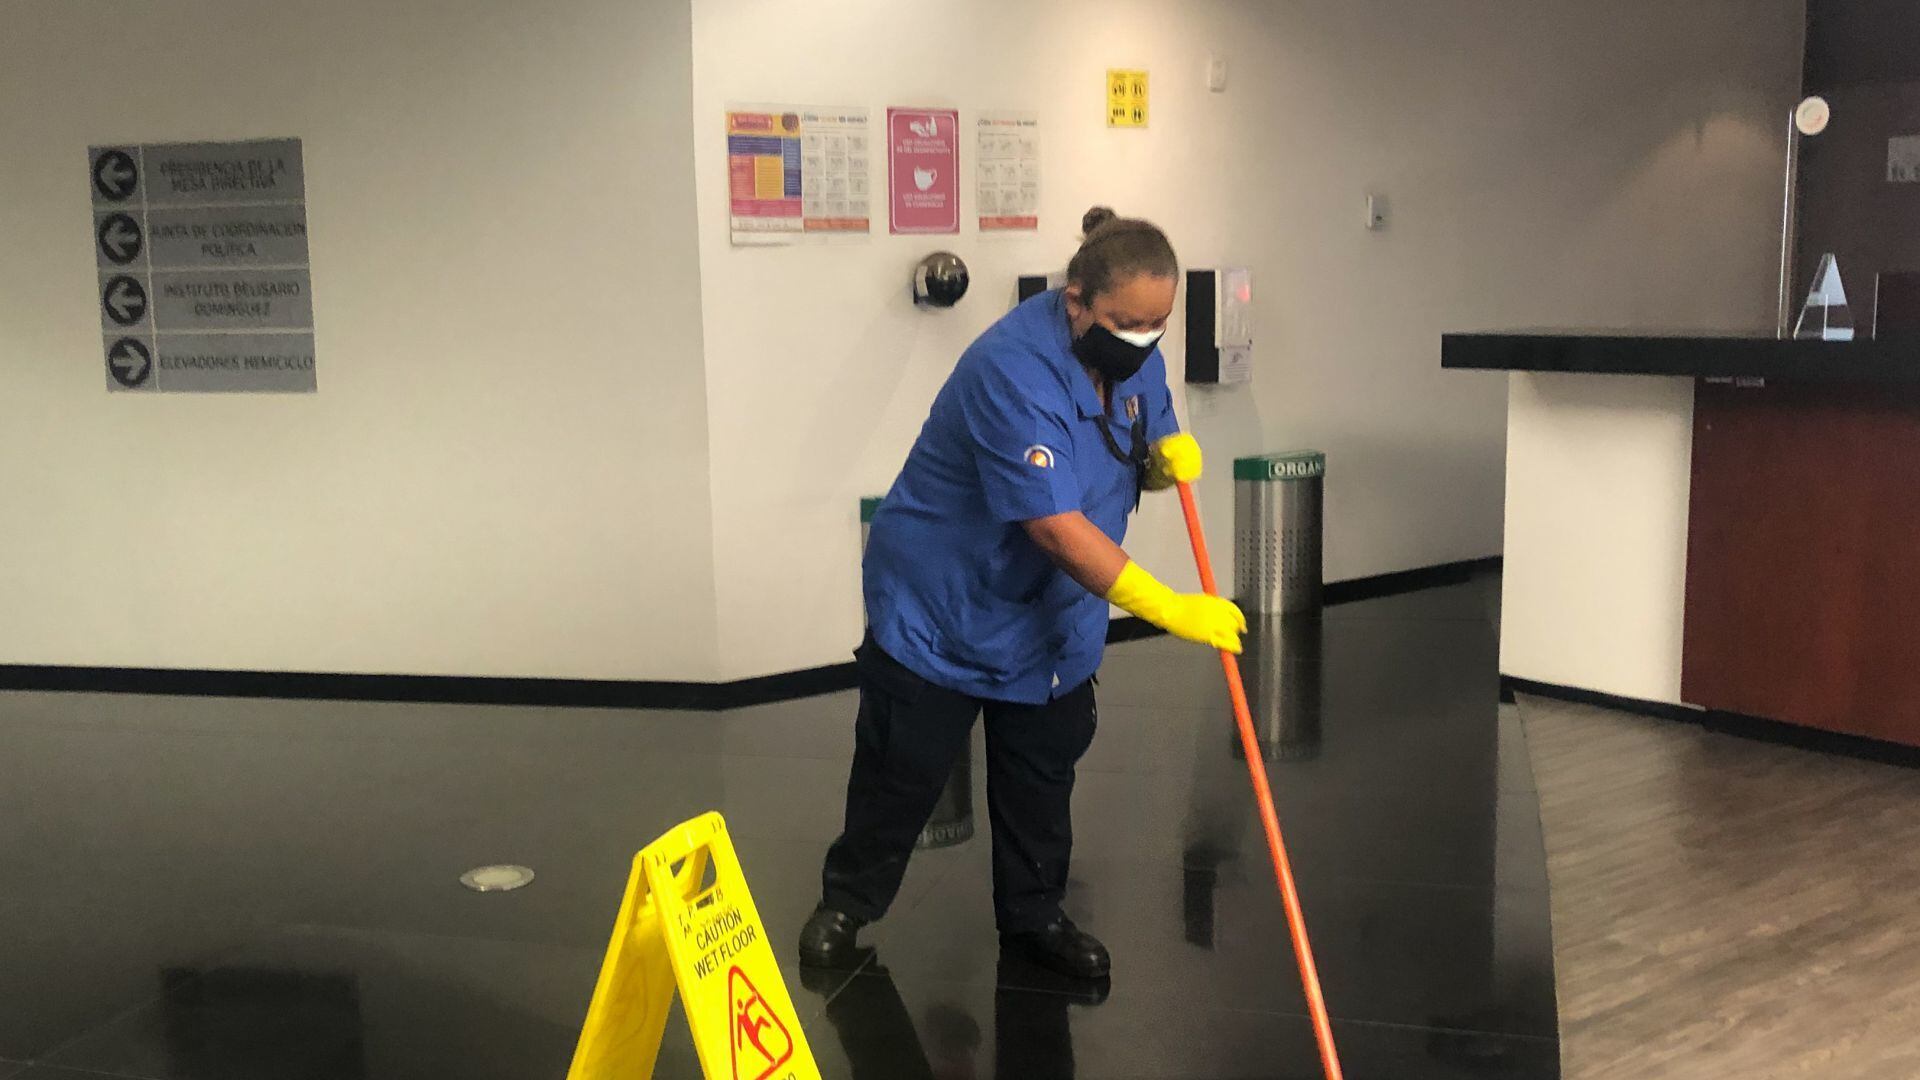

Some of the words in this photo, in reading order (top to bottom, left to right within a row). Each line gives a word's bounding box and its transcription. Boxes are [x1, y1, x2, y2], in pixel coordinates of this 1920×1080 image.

[693, 949, 719, 980] WET
[719, 924, 757, 963] FLOOR
[696, 908, 743, 950] CAUTION
